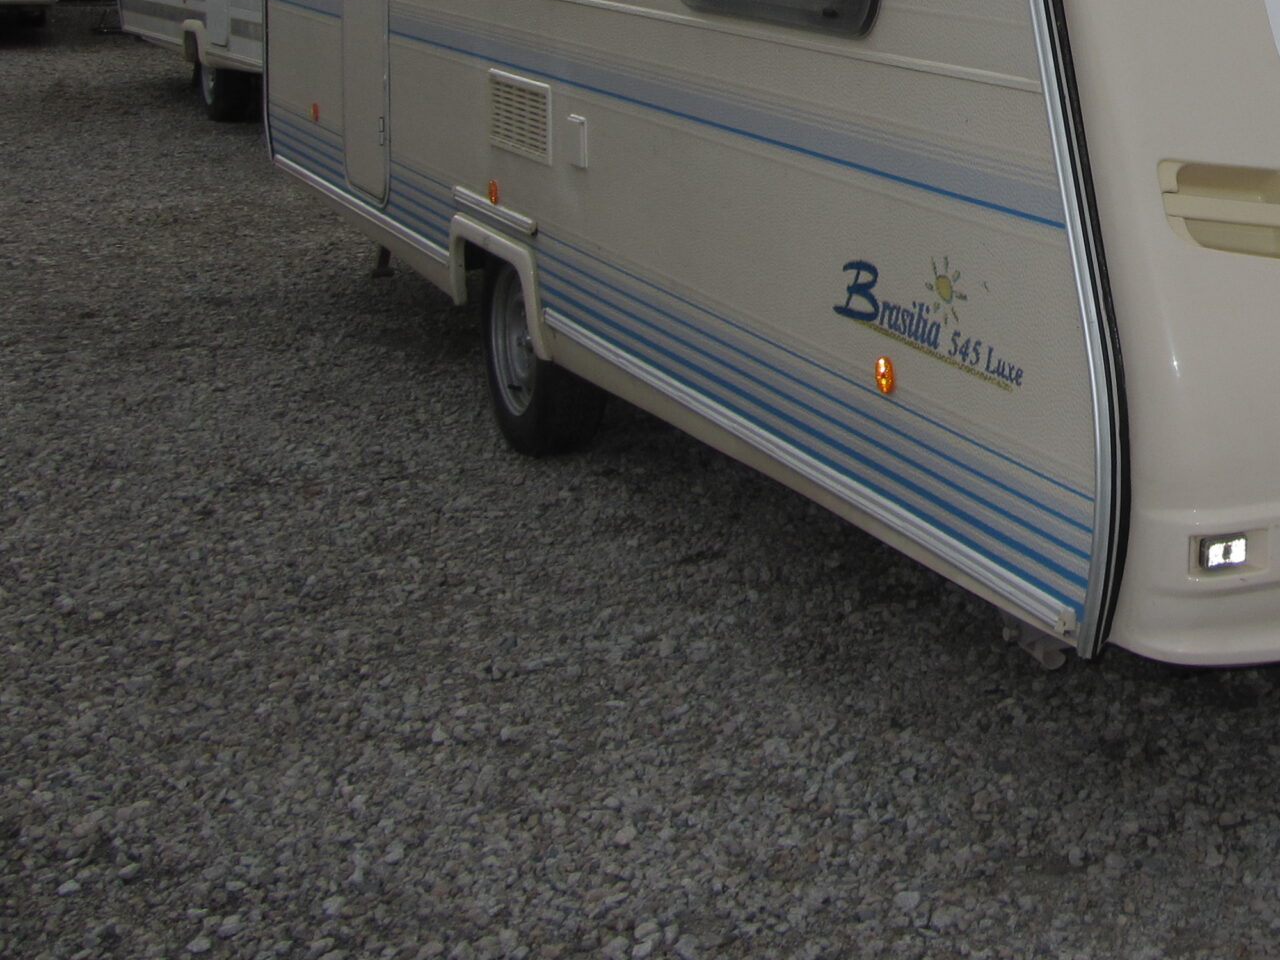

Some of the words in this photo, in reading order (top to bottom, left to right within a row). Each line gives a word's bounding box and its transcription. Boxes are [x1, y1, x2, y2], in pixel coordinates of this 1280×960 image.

[832, 259, 941, 350] Brasilia
[948, 330, 982, 366] 545
[985, 346, 1024, 386] Luxe
